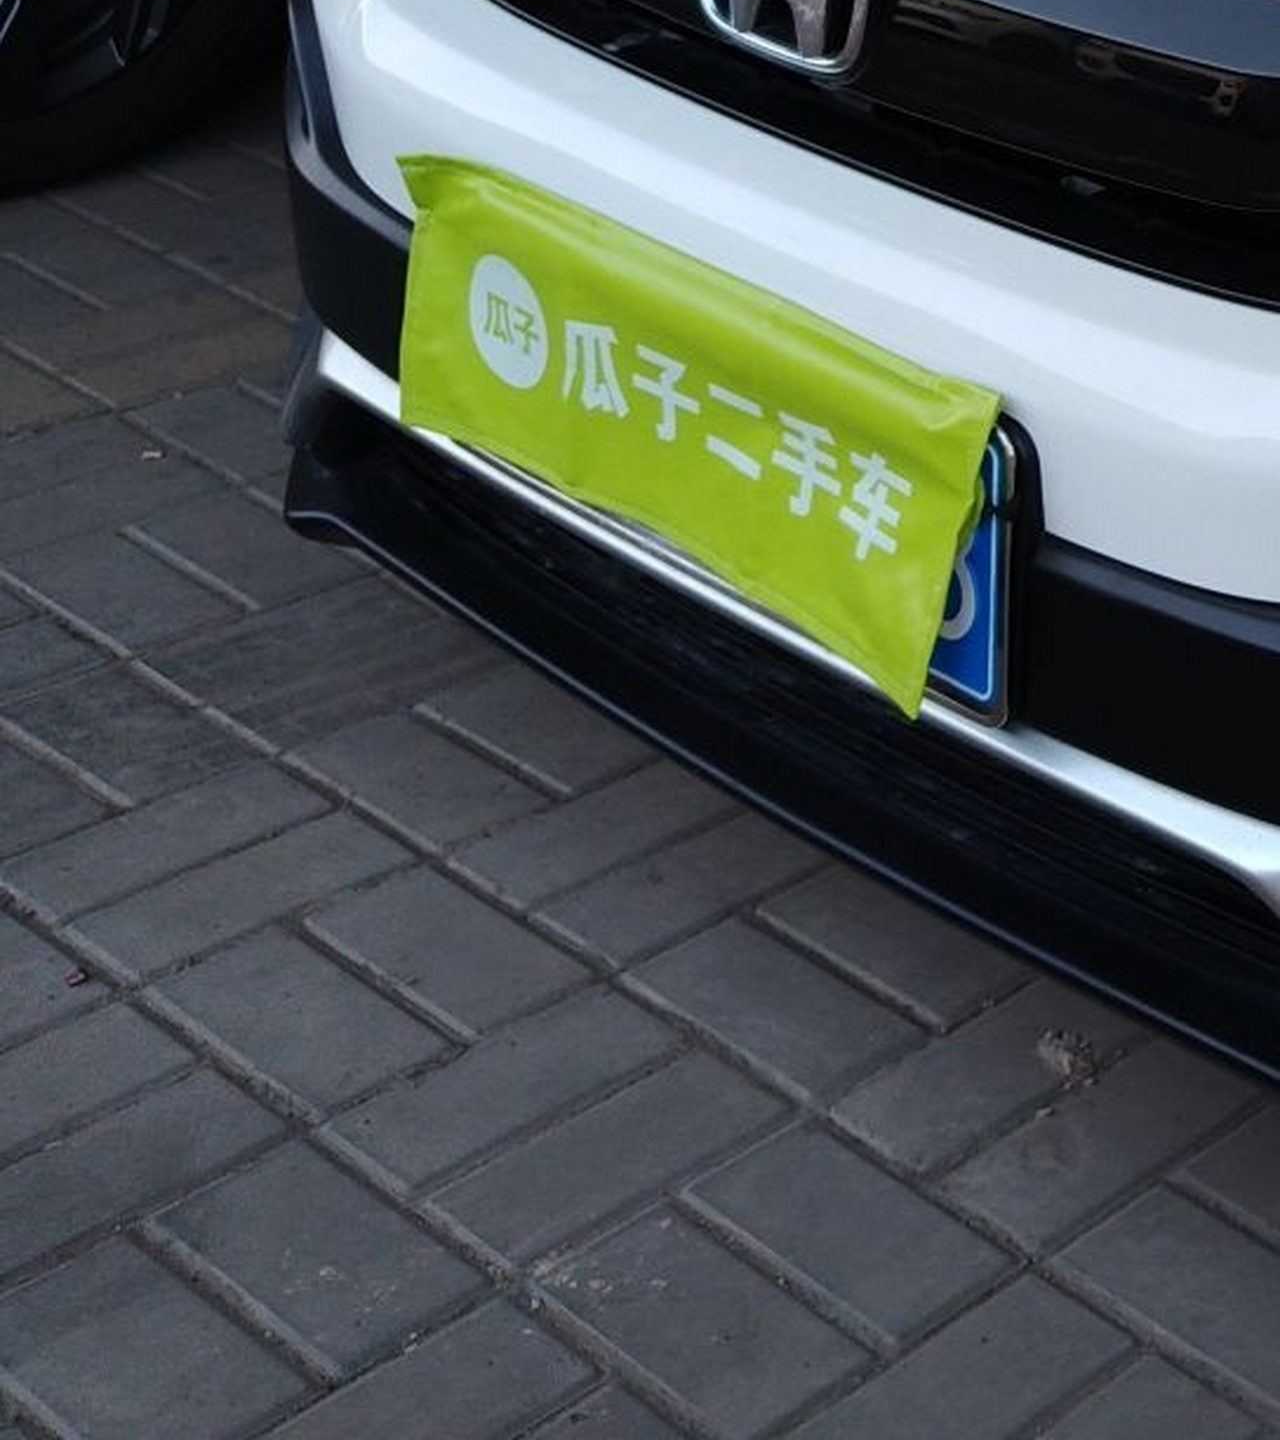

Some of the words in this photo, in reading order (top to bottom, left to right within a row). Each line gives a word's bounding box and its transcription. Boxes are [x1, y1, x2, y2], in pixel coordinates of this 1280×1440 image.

[484, 290, 541, 356] 瓜子
[562, 319, 912, 561] 瓜子二手车
